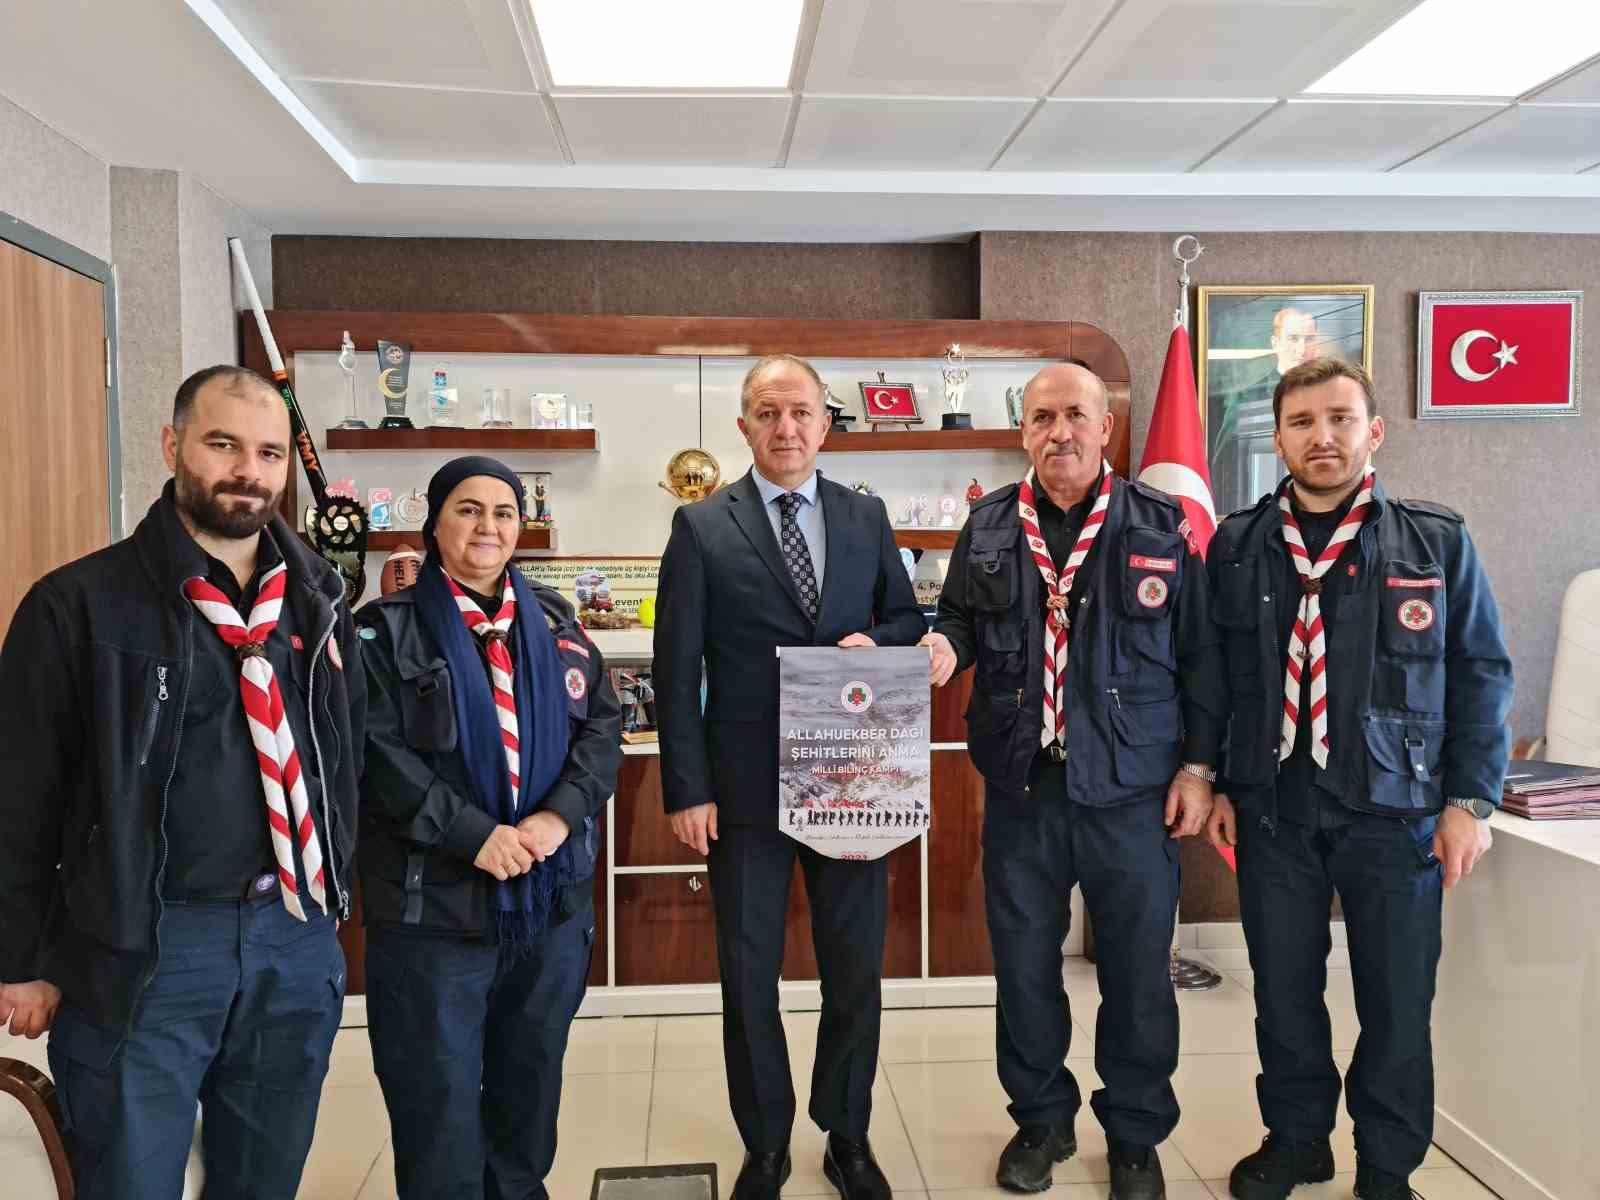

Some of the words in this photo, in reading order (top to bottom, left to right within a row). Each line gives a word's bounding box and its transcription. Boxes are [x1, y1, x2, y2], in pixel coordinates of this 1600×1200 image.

[787, 728, 887, 740] ALLAHUEKBER
[791, 744, 876, 760] ŞEHİTLERİNİ
[879, 744, 920, 760] ANMA
